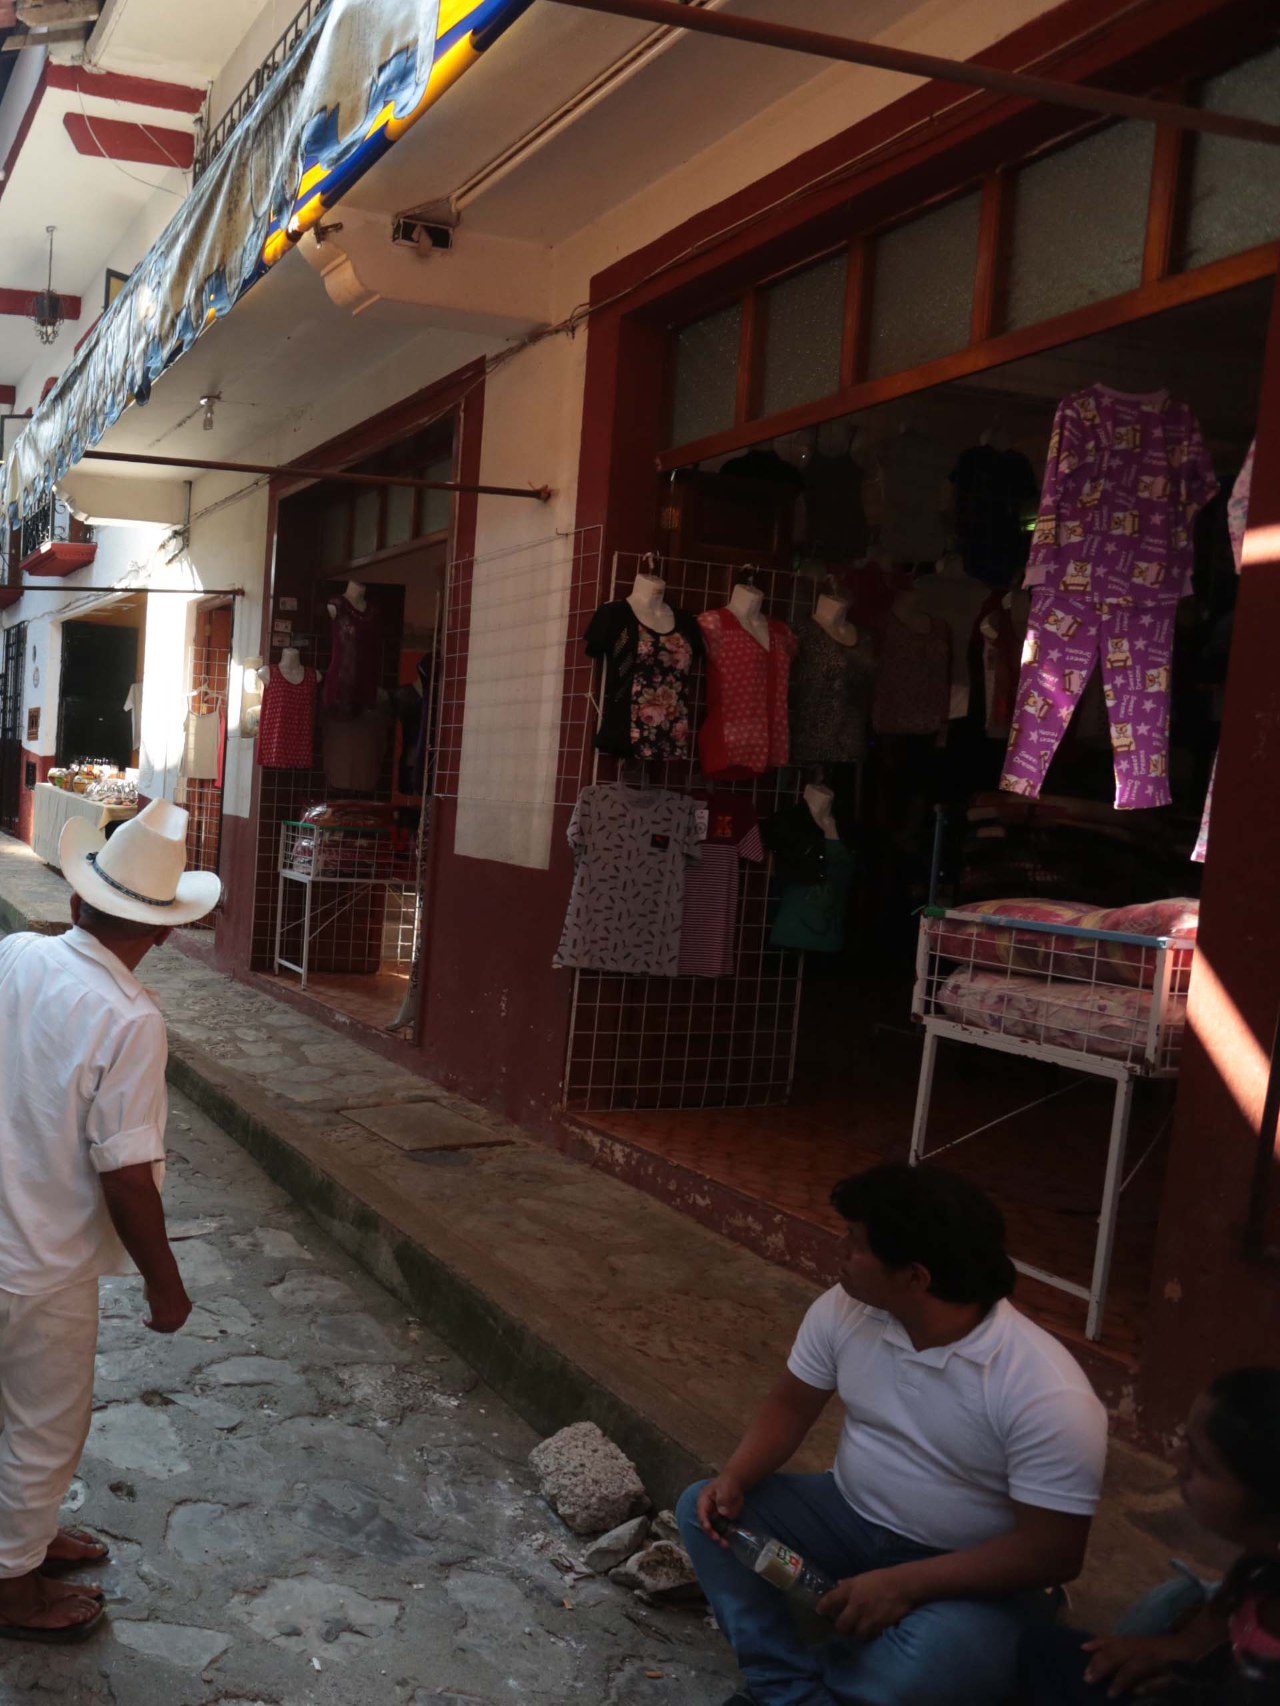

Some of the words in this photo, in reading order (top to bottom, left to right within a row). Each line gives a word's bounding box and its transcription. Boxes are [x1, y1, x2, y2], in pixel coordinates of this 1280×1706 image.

[1127, 670, 1135, 691] Sweet
[1119, 694, 1130, 718] Dreams
[1128, 695, 1137, 716] Sweet
[1131, 755, 1139, 776] Sweet
